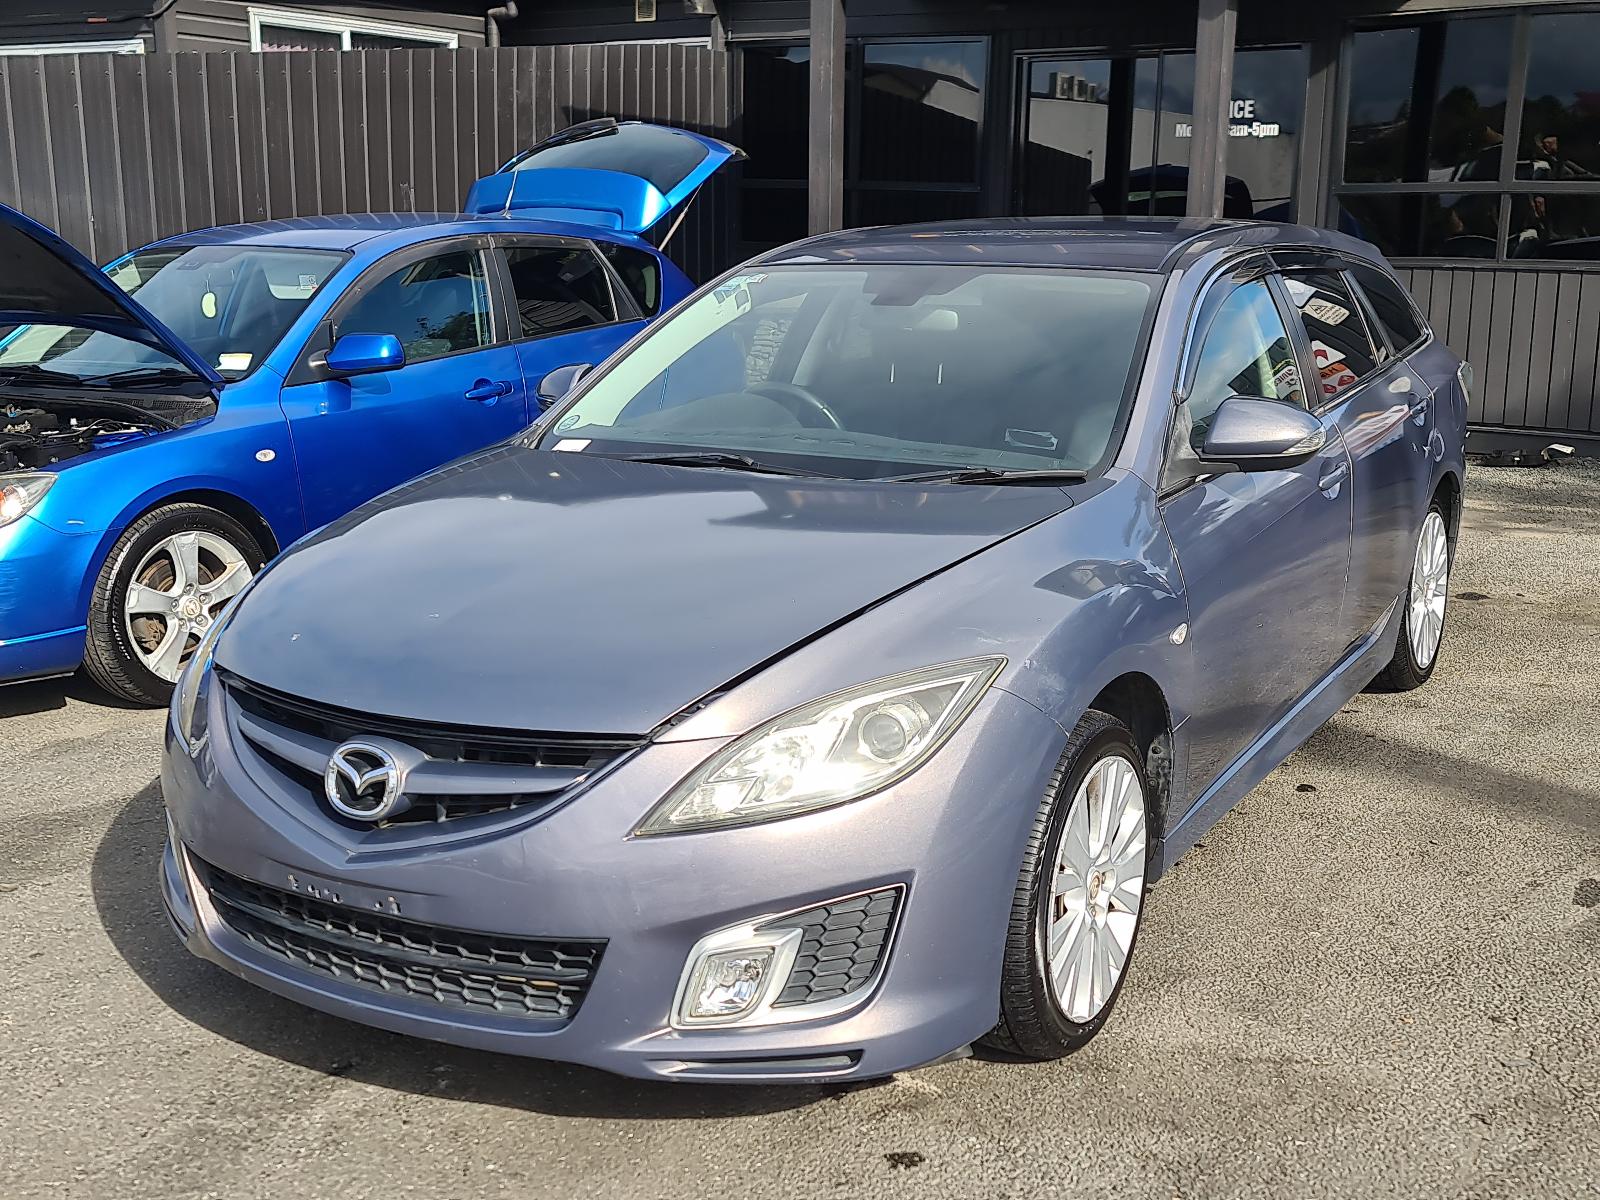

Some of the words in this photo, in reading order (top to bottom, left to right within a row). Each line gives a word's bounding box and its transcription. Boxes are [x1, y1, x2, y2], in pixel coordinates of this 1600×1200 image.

[1228, 99, 1255, 119] ICE
[1175, 123, 1193, 138] Mo
[1228, 121, 1280, 138] am-5pm
